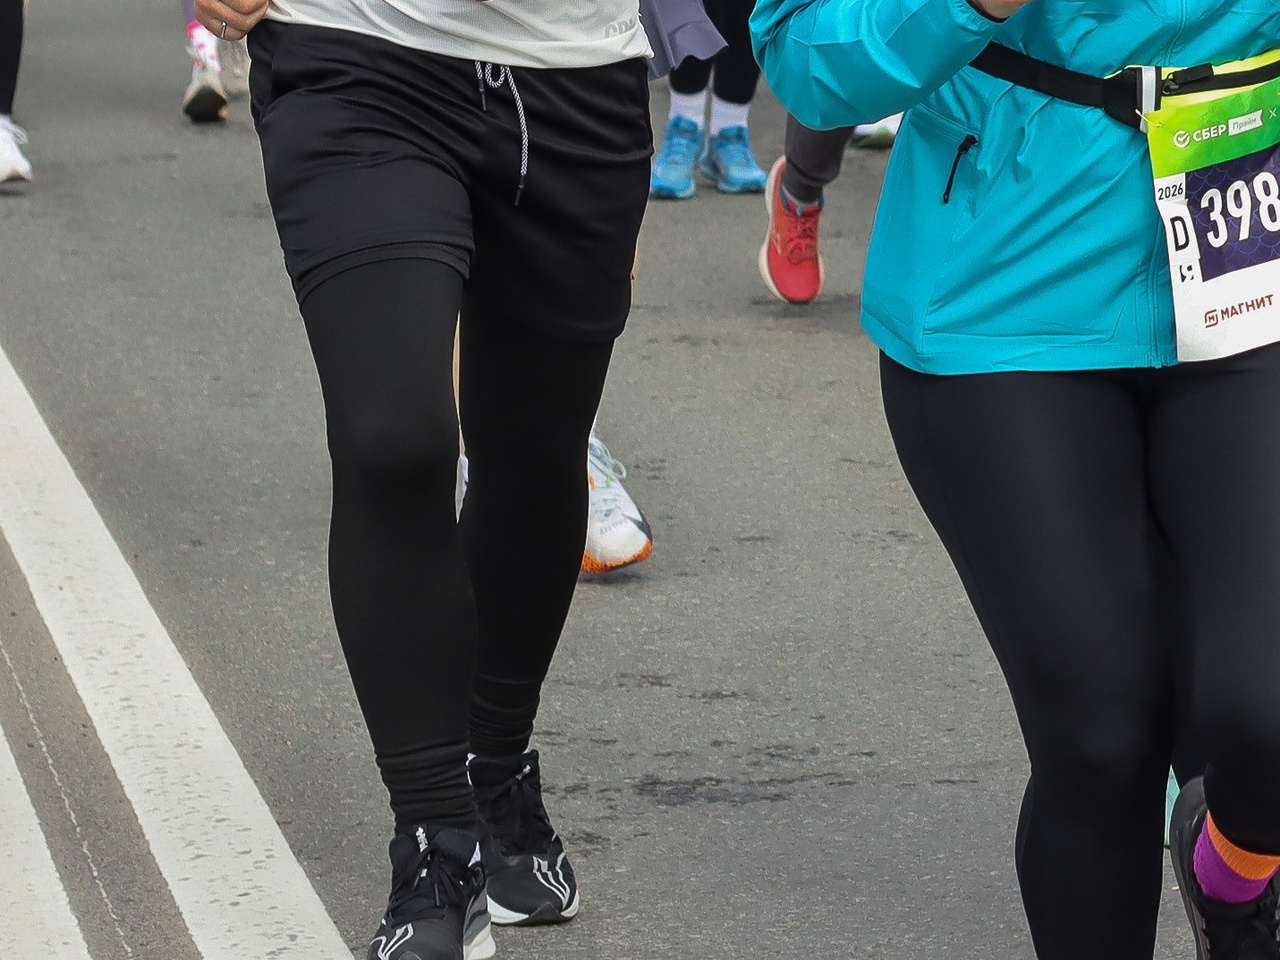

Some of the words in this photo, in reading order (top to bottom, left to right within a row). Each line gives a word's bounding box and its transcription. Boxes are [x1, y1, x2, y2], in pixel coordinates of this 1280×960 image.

[1193, 124, 1227, 142] СБЕР
[1233, 117, 1257, 130] Прайм
[1158, 181, 1184, 201] 2026
[1169, 215, 1190, 252] D
[1221, 294, 1274, 321] МАГНИТ
